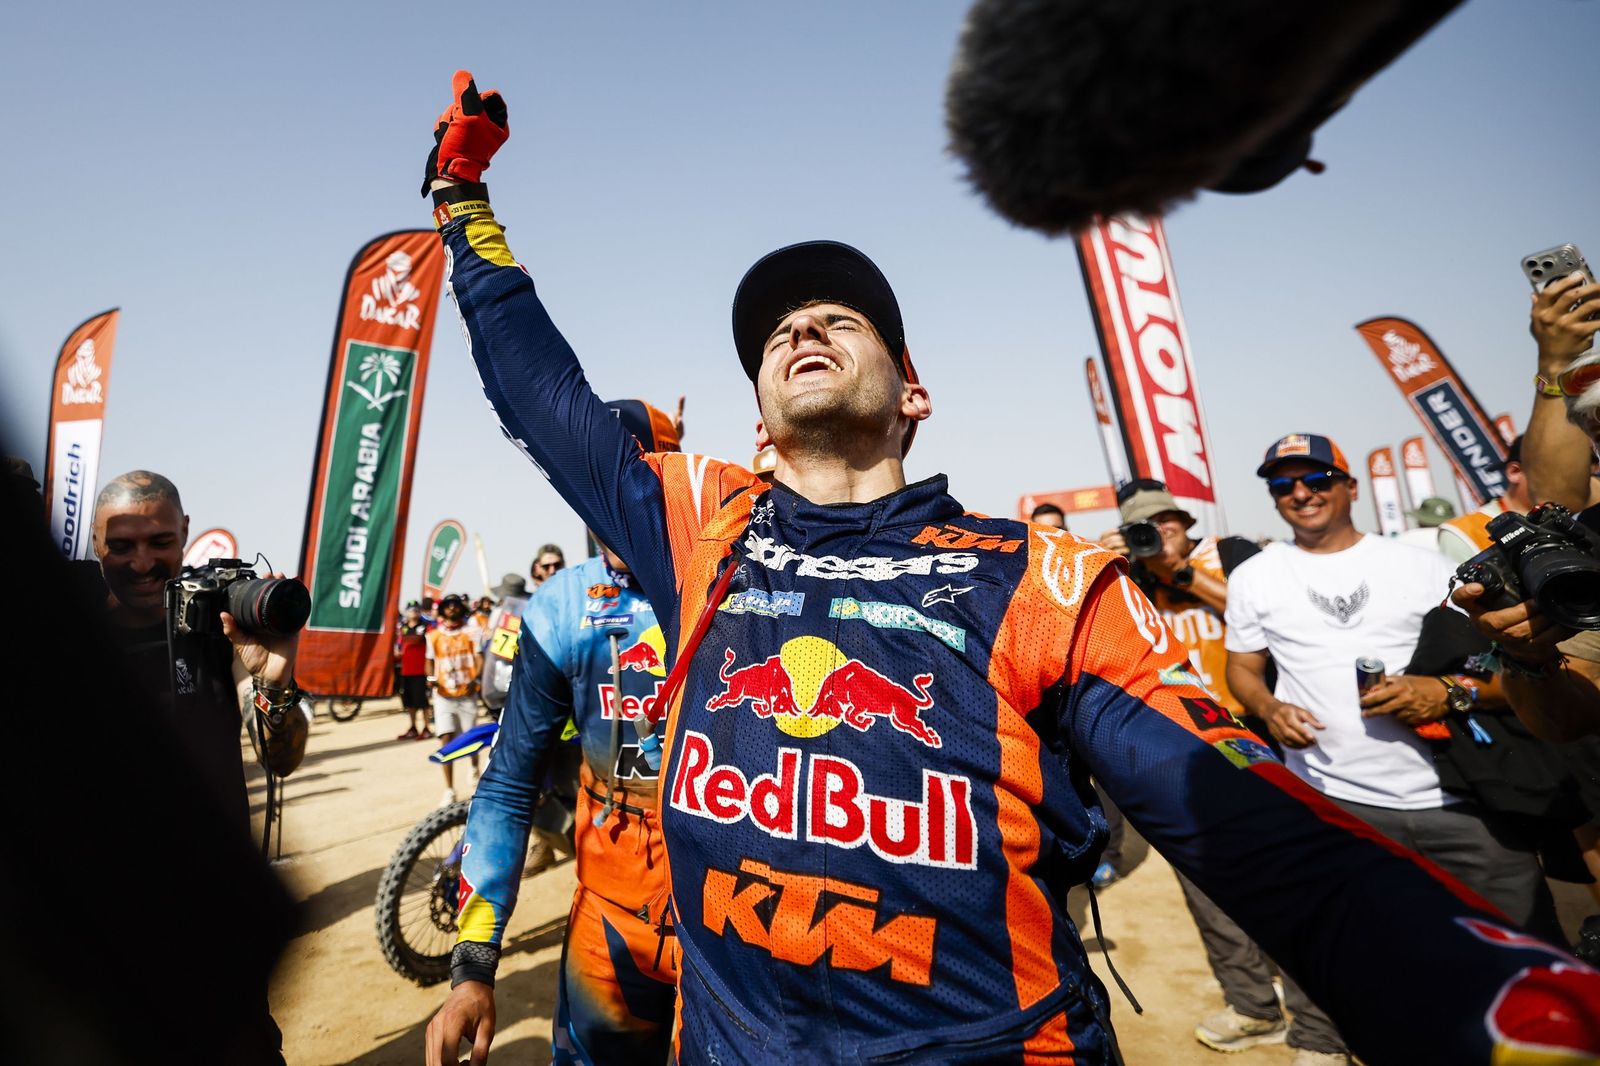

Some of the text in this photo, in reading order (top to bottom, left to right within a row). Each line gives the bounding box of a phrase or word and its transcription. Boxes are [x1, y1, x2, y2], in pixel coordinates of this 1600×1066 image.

[360, 293, 421, 331] DAKAR
[61, 442, 82, 560] oodrich
[338, 422, 383, 609] SAUDI ARABIA
[910, 524, 1025, 553] KTM
[1500, 526, 1526, 545] Nikon
[500, 633, 510, 652] 7
[670, 730, 978, 871] Red Bull
[703, 858, 937, 987] KTM
